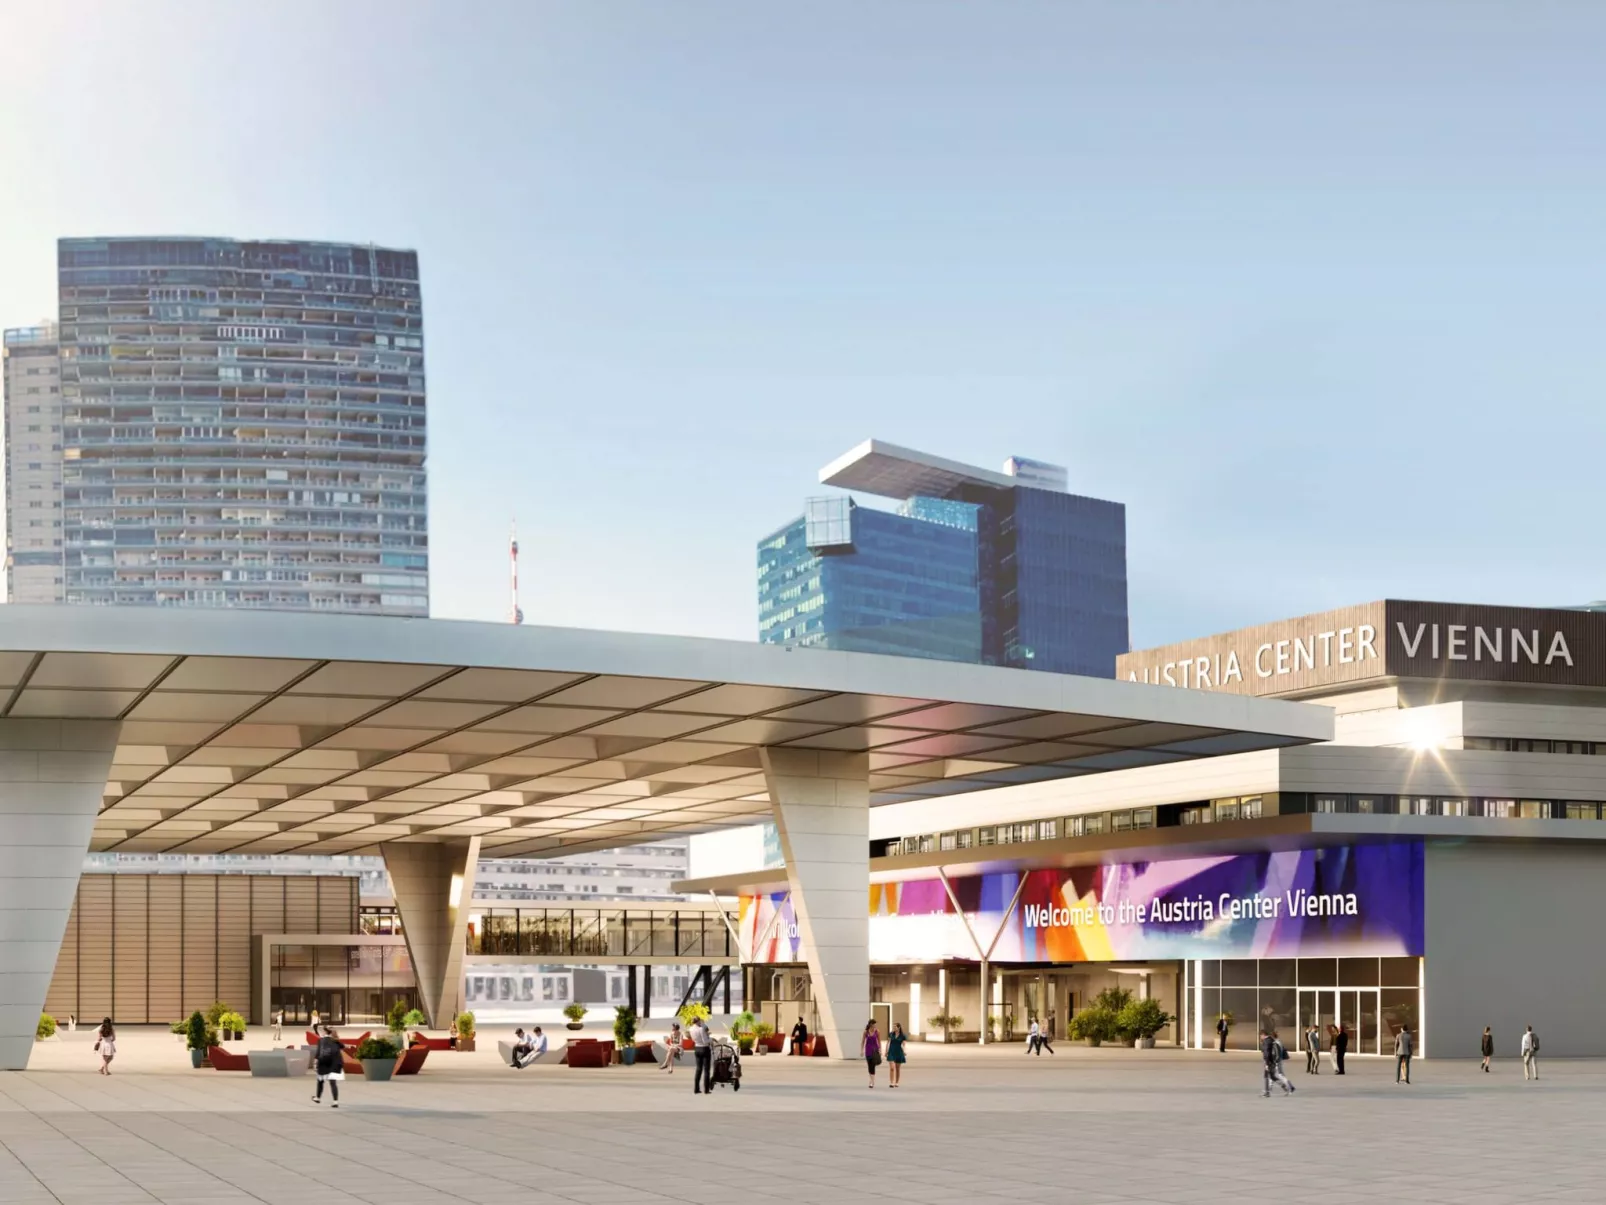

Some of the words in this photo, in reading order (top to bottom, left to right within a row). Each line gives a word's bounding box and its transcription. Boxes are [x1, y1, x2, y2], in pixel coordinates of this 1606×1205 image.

[1255, 623, 1378, 678] CENTER
[1396, 622, 1574, 666] VIENNA
[1025, 902, 1094, 928] Welcome
[1100, 903, 1115, 925] to
[1119, 899, 1146, 924] the
[1150, 896, 1214, 923] Austria
[1219, 893, 1281, 919] Center
[1287, 888, 1358, 917] Vienna
